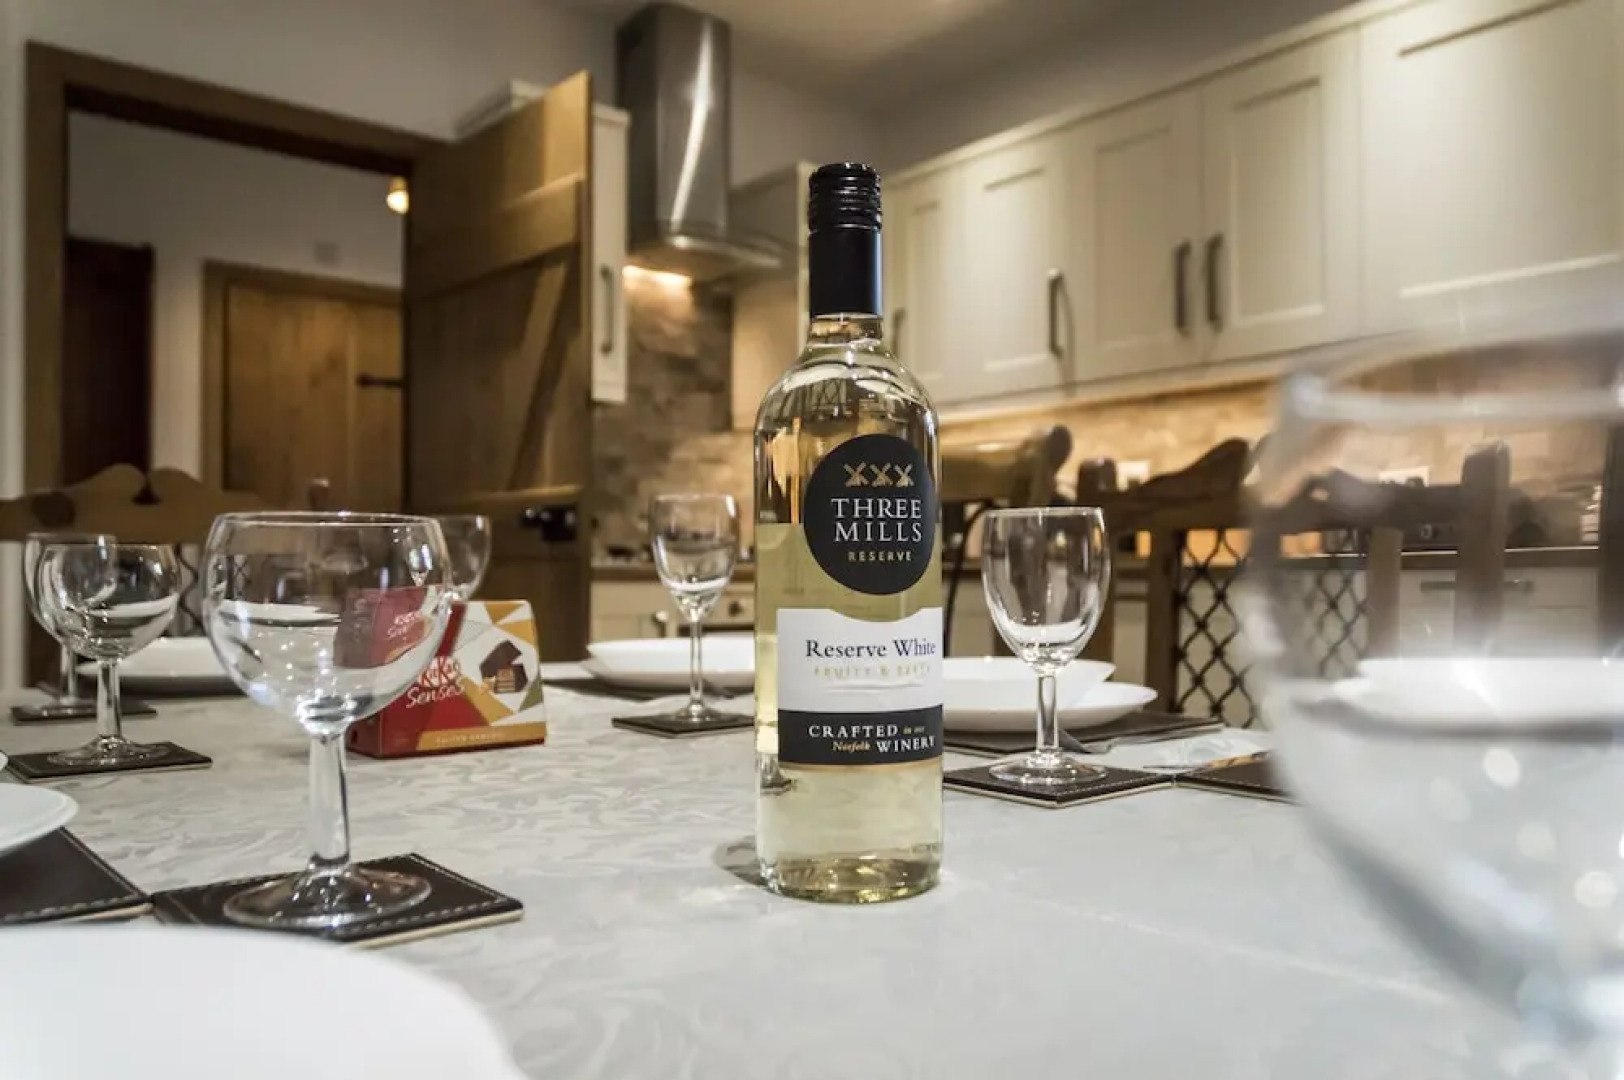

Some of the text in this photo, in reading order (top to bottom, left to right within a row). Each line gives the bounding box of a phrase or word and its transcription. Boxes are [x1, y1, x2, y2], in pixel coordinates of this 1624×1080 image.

[831, 498, 922, 518] THREE
[834, 521, 922, 542] MILLS
[848, 551, 912, 562] RESERVE
[805, 638, 936, 658] Reserve White
[405, 680, 465, 709] Senses
[808, 724, 899, 739] CRAFTED
[876, 735, 936, 753] WINERY
